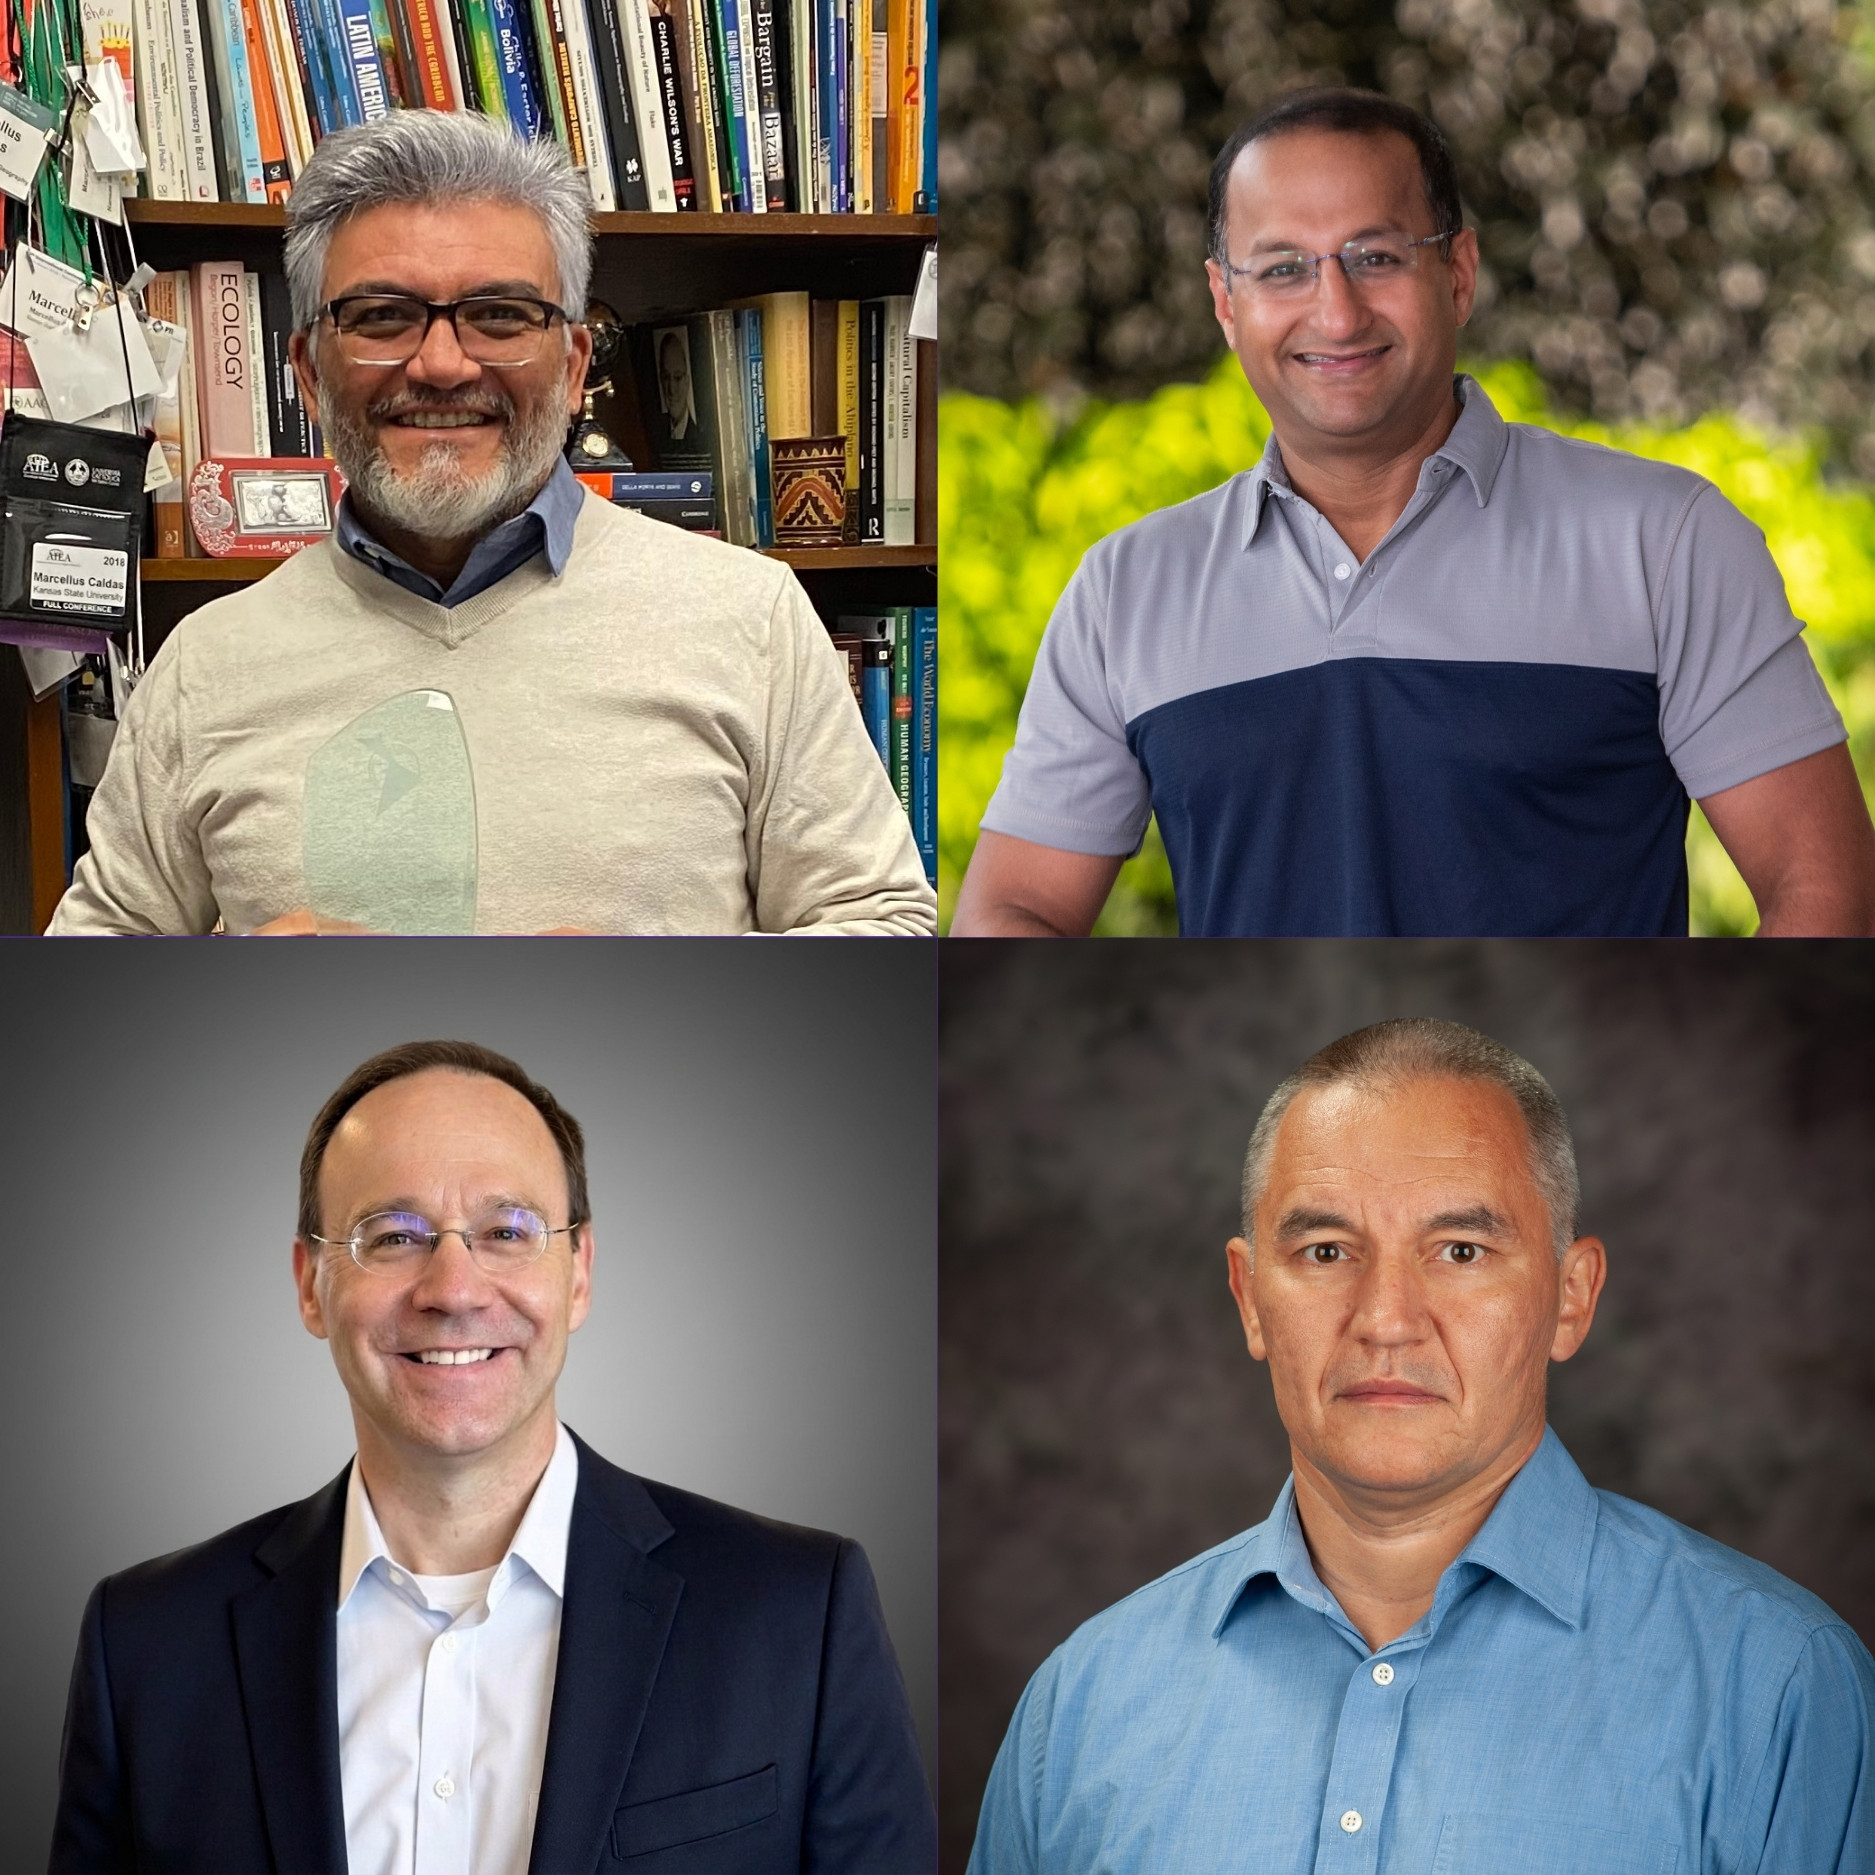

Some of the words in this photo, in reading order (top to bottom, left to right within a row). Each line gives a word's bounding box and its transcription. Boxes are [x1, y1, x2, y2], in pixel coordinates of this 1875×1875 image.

[183, 29, 192, 44] and
[228, 3, 241, 46] Caribbean
[346, 15, 375, 59] LATIN
[421, 22, 433, 39] AND
[425, 41, 436, 57] THE
[500, 28, 516, 74] Bolivia
[558, 42, 570, 76] REBELDE
[637, 35, 647, 59] Beauty
[658, 21, 672, 74] CHARLIE
[726, 30, 741, 59] GLOBAL
[755, 12, 774, 87] Bargain
[148, 40, 160, 99] Environmental
[185, 48, 197, 82] Political
[428, 57, 445, 101] CARIBBEAN
[641, 60, 648, 68] of
[643, 69, 651, 92] Nature
[701, 70, 707, 81] DA
[355, 63, 387, 121] AMERIC
[728, 60, 744, 117] DEFORESTATION
[903, 66, 919, 105] 2
[153, 101, 164, 130] Politics
[189, 86, 201, 133] Democracy
[664, 77, 681, 136] WILSON'S
[702, 83, 711, 126] FRONTEIRA
[0, 120, 21, 143] llus
[157, 132, 165, 146] and
[194, 136, 203, 144] in
[764, 115, 782, 178] Bazaar
[157, 149, 167, 172] Policy
[196, 147, 206, 171] Brazil
[672, 138, 684, 166] WAR
[29, 290, 76, 321] Marcell
[210, 274, 222, 386] Begon/Harper/Townsend
[221, 273, 243, 390] ECOLOGY
[846, 320, 856, 362] Politics
[902, 326, 912, 371] atural
[750, 361, 758, 380] Study
[846, 366, 856, 376] in
[846, 381, 856, 400] the
[900, 375, 912, 439] Capitalism
[844, 404, 856, 457] Altiplano
[103, 556, 125, 566] 2018
[33, 572, 85, 586] Marcellus
[88, 577, 124, 589] Caldas
[33, 586, 62, 595] Kansas
[64, 589, 84, 598] State
[86, 591, 123, 602] University
[43, 601, 62, 609] FULL
[63, 602, 112, 613] CONFERENCE
[924, 639, 935, 661] The
[923, 663, 935, 698] World
[900, 724, 909, 761] HUMAN
[921, 700, 933, 752] Economy
[881, 748, 889, 769] GEOG
[900, 765, 909, 816] GEOGRAP
